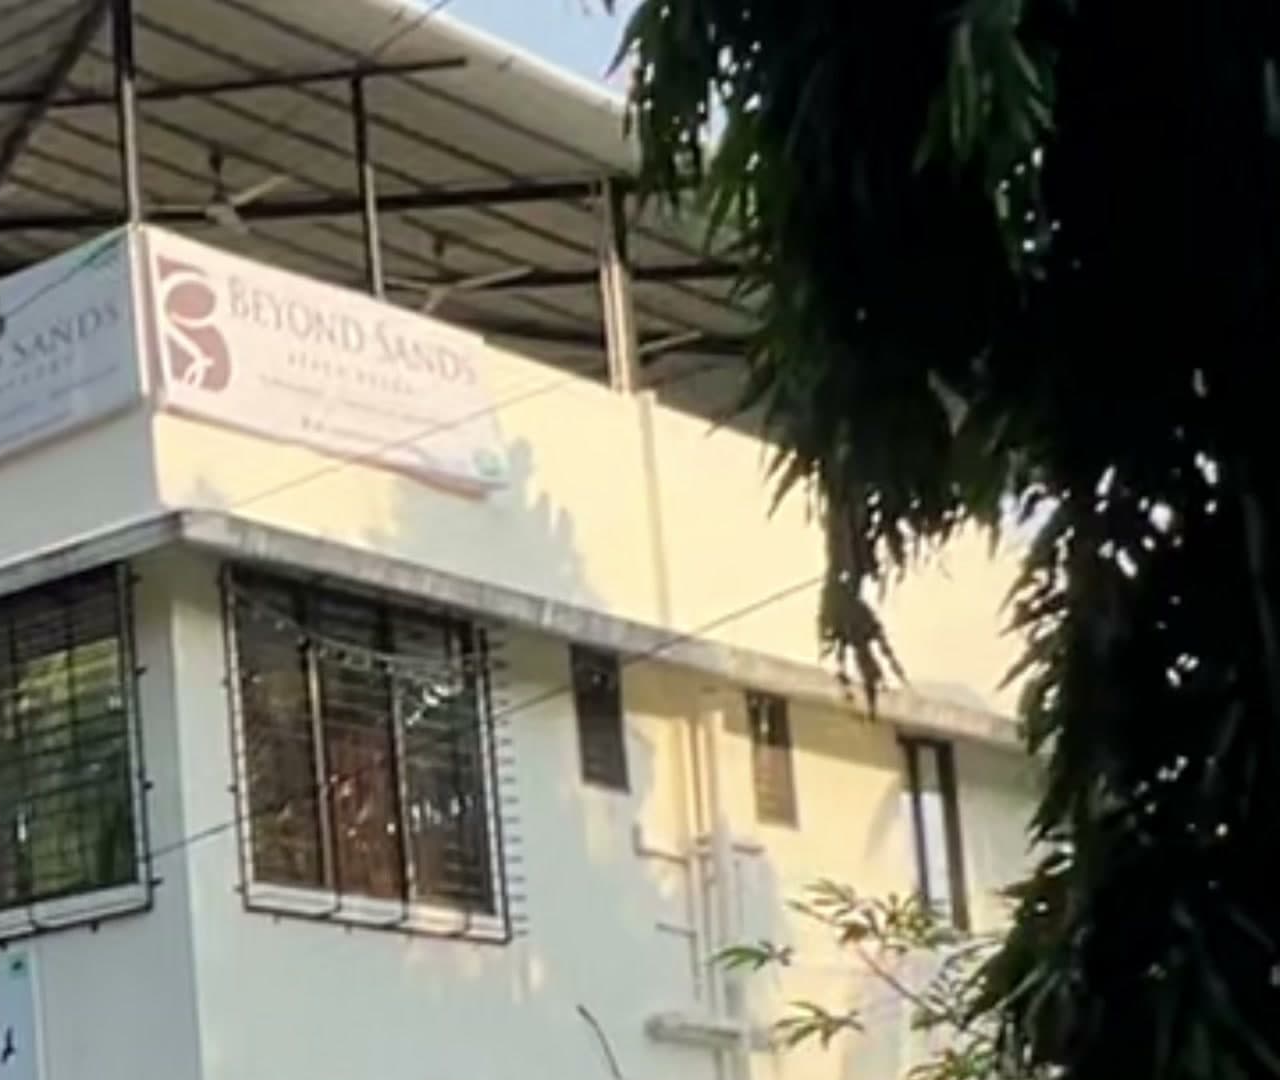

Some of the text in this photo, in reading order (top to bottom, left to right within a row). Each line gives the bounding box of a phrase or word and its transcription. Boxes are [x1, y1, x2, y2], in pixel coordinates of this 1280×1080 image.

[11, 301, 120, 366] SANDS
[227, 273, 365, 352] BEYOND
[374, 319, 478, 386] SANDS
